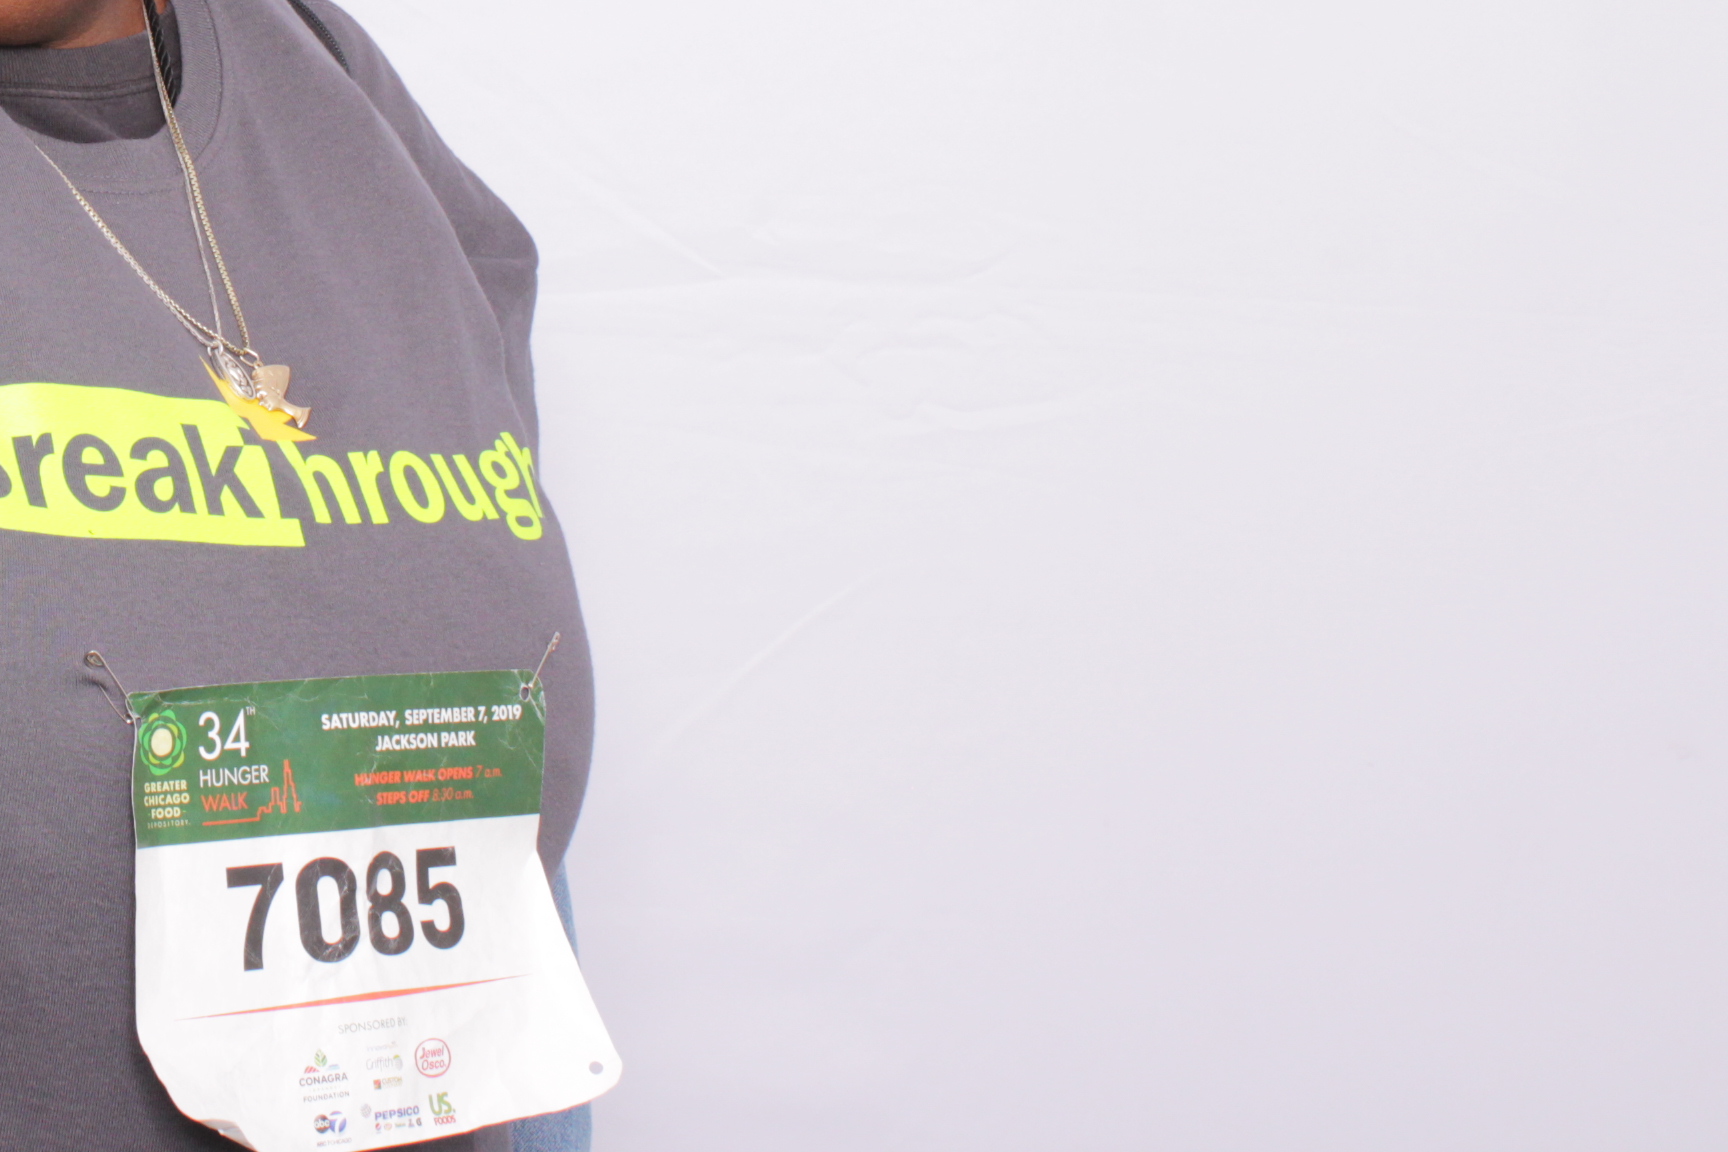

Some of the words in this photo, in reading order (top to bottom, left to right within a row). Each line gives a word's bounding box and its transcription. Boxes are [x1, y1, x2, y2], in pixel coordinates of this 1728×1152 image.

[321, 710, 400, 730] SATURDAY,
[404, 707, 475, 726] SEPTEMBER
[477, 706, 488, 724] 7,
[491, 704, 522, 721] 2019
[375, 733, 438, 751] JACKSON
[441, 731, 476, 747] PARK
[199, 765, 269, 788] HUNGER
[354, 771, 401, 786] HUNGER
[403, 769, 436, 783] WALK
[438, 767, 474, 781] OPENS
[475, 765, 483, 778] 7
[144, 780, 188, 793] GREATER
[144, 793, 190, 807] CHICAGO
[200, 792, 249, 812] WALK
[376, 791, 407, 805] STEPS
[409, 790, 431, 803] OFF
[433, 788, 453, 802] 8:30
[151, 807, 181, 819] FOOD
[225, 846, 465, 972] 7085
[338, 1017, 396, 1034] SPONSORED
[419, 1046, 444, 1059] Jewel
[299, 1073, 348, 1087] CONAGRA
[303, 1091, 350, 1103] FOUNDATION
[374, 1105, 420, 1121] PEPSICO
[434, 1115, 457, 1126] FOODS
